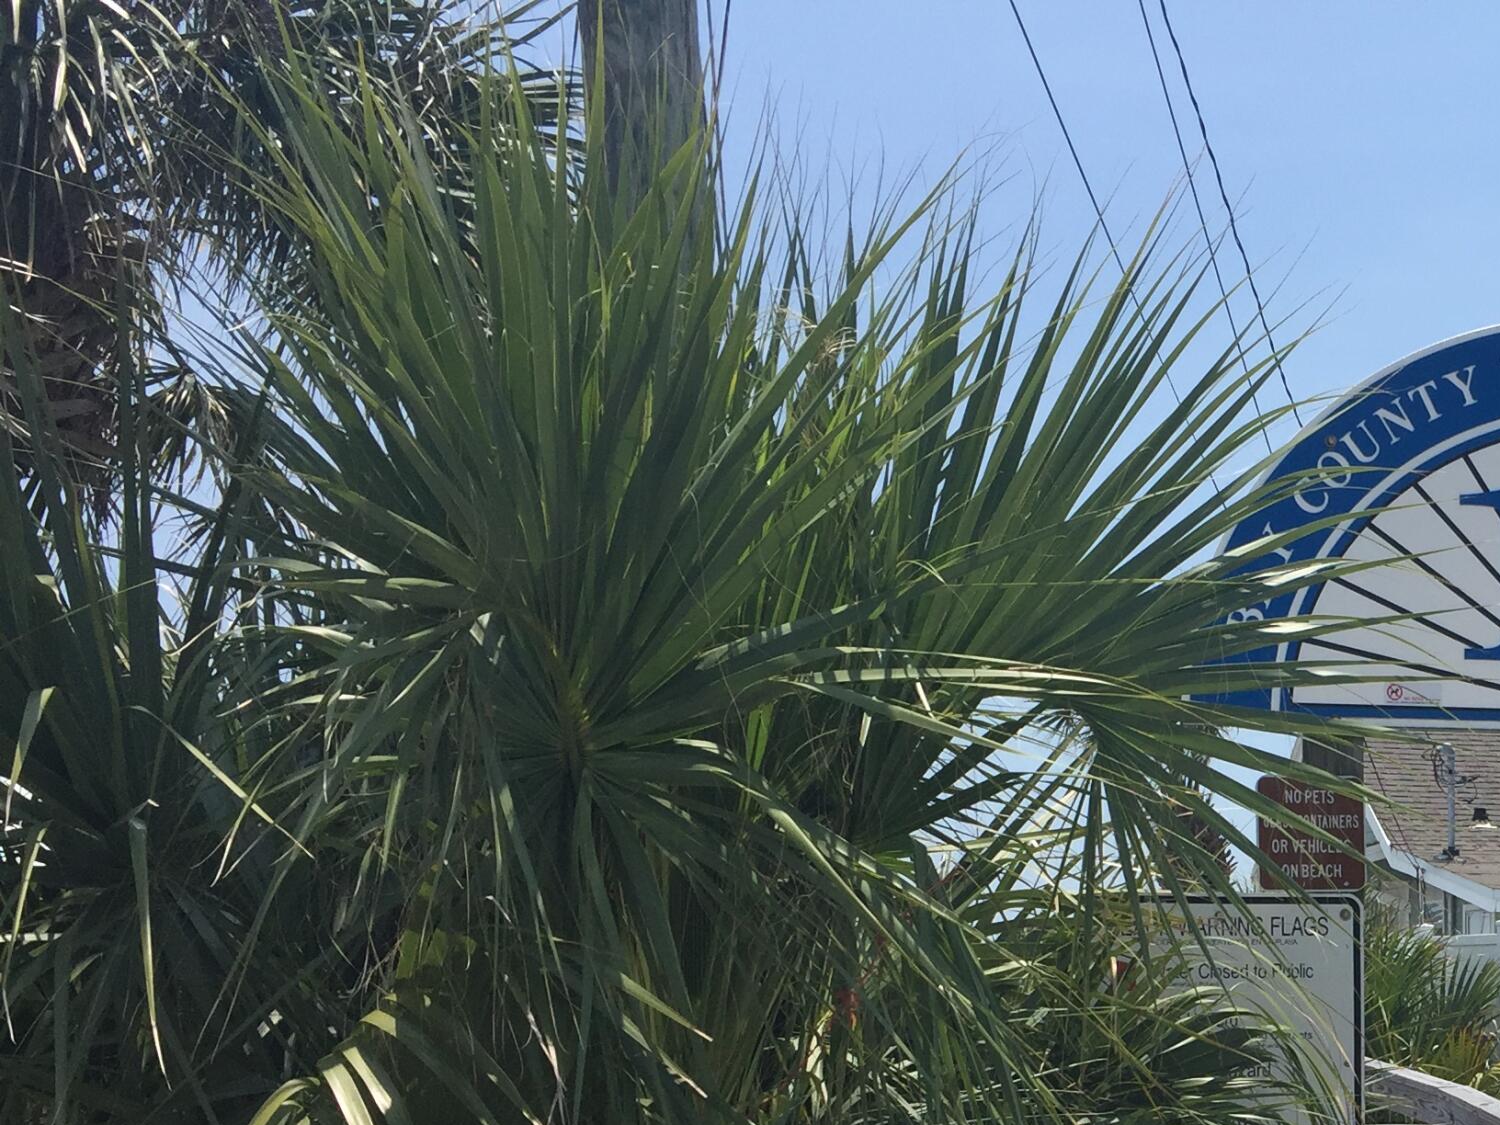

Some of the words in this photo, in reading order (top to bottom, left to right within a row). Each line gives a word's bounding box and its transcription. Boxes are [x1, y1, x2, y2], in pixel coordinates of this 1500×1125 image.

[1293, 365, 1478, 514] COUNTY
[1284, 789, 1301, 804] NO
[1304, 789, 1335, 805] PETS
[1299, 814, 1360, 829] ONTAINERS
[1271, 839, 1289, 854] OR
[1292, 839, 1353, 854] VEHICLE
[1281, 863, 1299, 878] ON
[1301, 863, 1343, 878] BEACH
[1270, 915, 1330, 937] FLAGS
[1198, 963, 1249, 980] Closed
[1253, 964, 1267, 979] to
